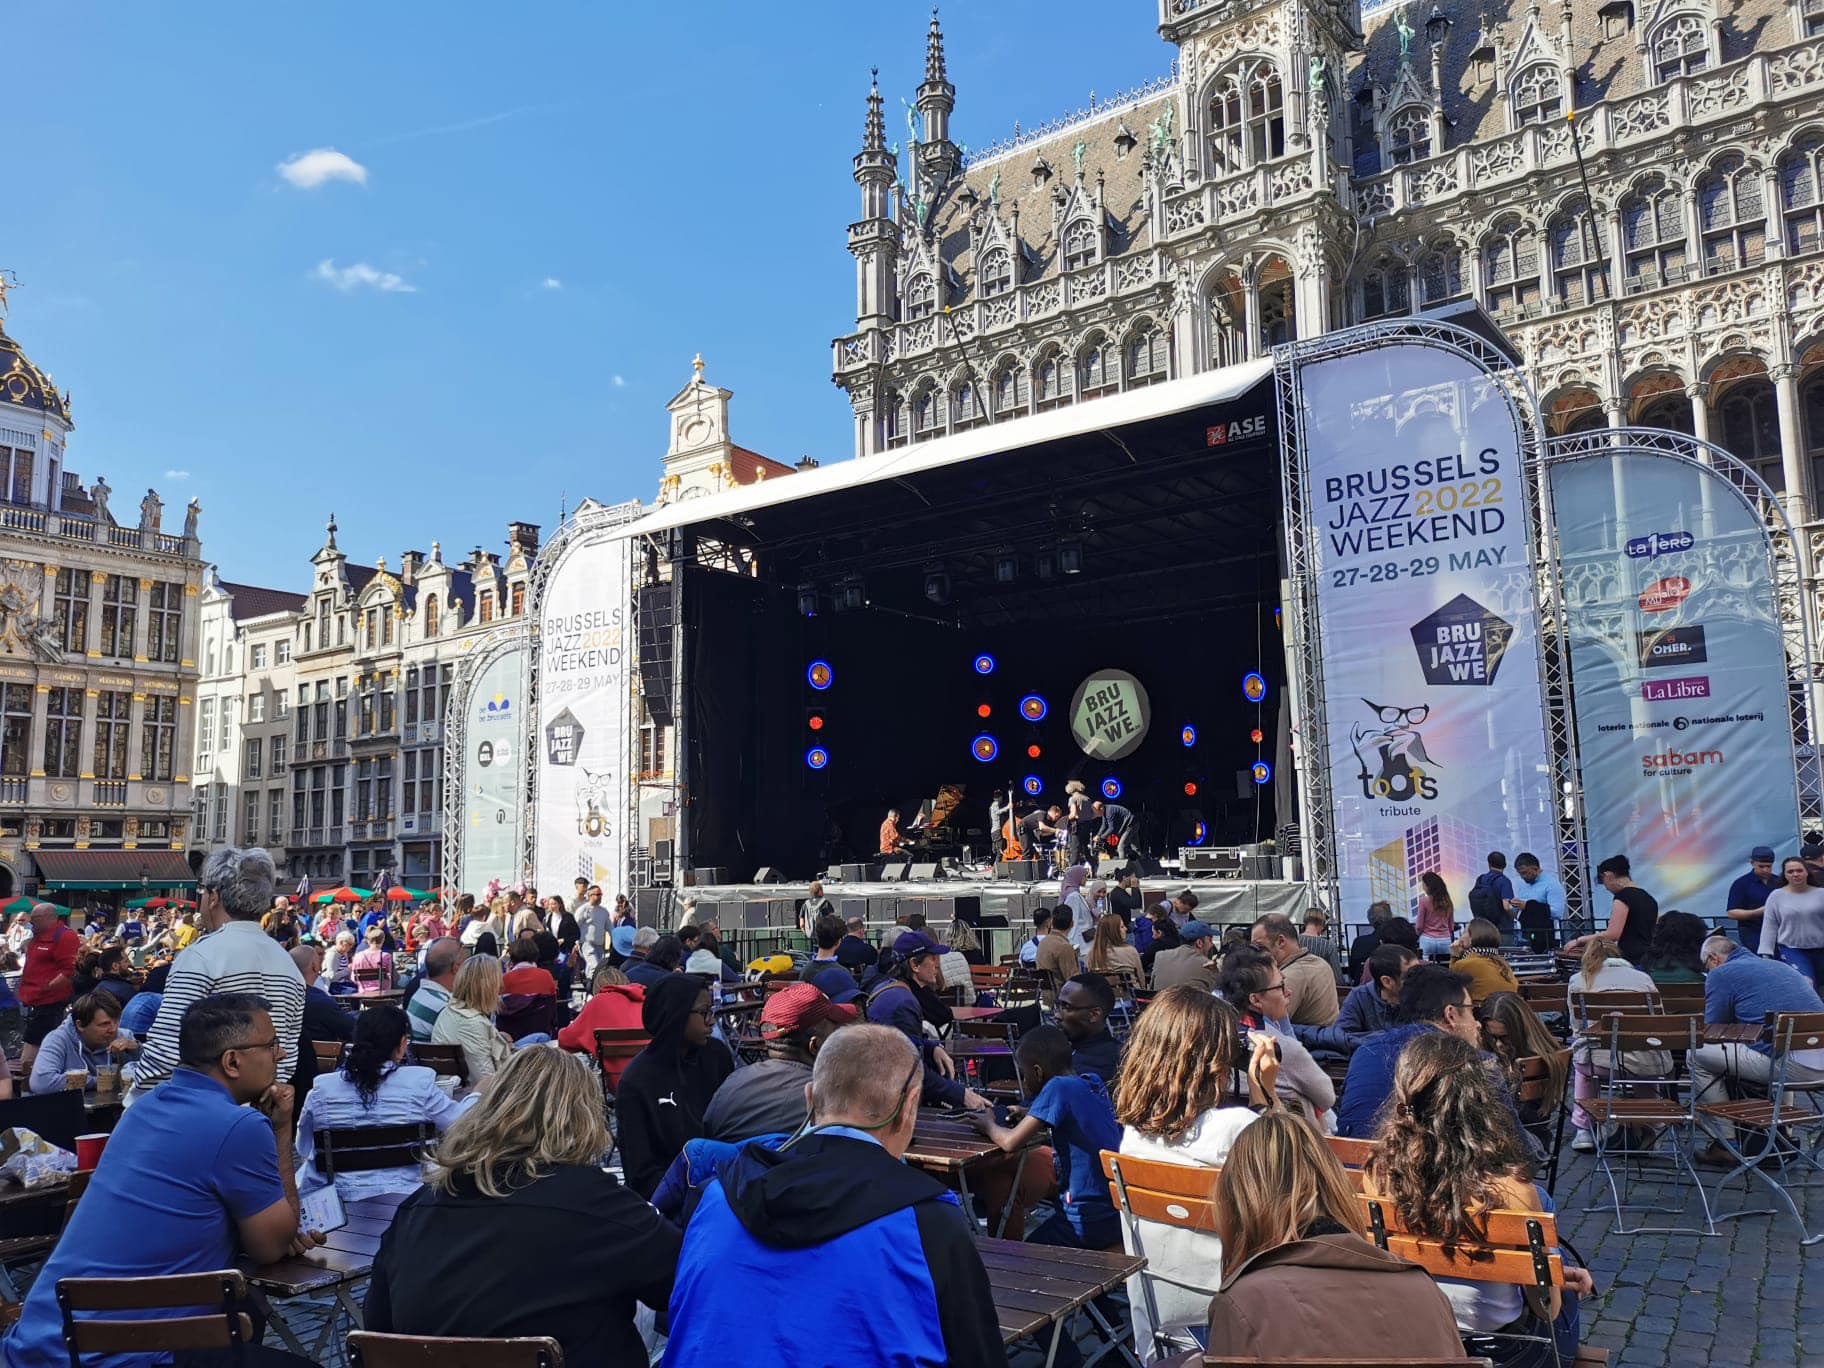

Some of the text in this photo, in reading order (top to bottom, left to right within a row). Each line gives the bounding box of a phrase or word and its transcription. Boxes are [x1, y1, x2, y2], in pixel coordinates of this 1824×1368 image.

[1228, 416, 1265, 437] ASE
[1326, 448, 1500, 502] BRUSSELS
[1329, 478, 1504, 529] JAZZ 2022
[1331, 508, 1505, 557] WEEKEND
[1333, 546, 1507, 588] 27-28-29 MAY
[547, 608, 621, 636] BRUSSELS
[547, 628, 621, 655] JAZZ 2022
[1436, 623, 1481, 644] BRU
[547, 648, 621, 673] WEEKEND
[1431, 643, 1483, 669] JAZZ
[594, 673, 620, 689] MAY
[1448, 662, 1485, 681] WE
[1085, 683, 1121, 712] BRU
[1647, 681, 1705, 699] La Libre
[1085, 699, 1128, 738] JAZZ
[1598, 724, 1626, 732] loterie
[1691, 715, 1734, 725] nationale
[1736, 712, 1763, 721] loterij
[554, 725, 573, 738] BRU
[551, 737, 573, 754] JAZZ
[557, 750, 573, 763] WE
[1642, 748, 1724, 769] sabam
[1643, 767, 1692, 777] for culture
[1358, 766, 1439, 801] toots
[1380, 806, 1421, 817] tribute
